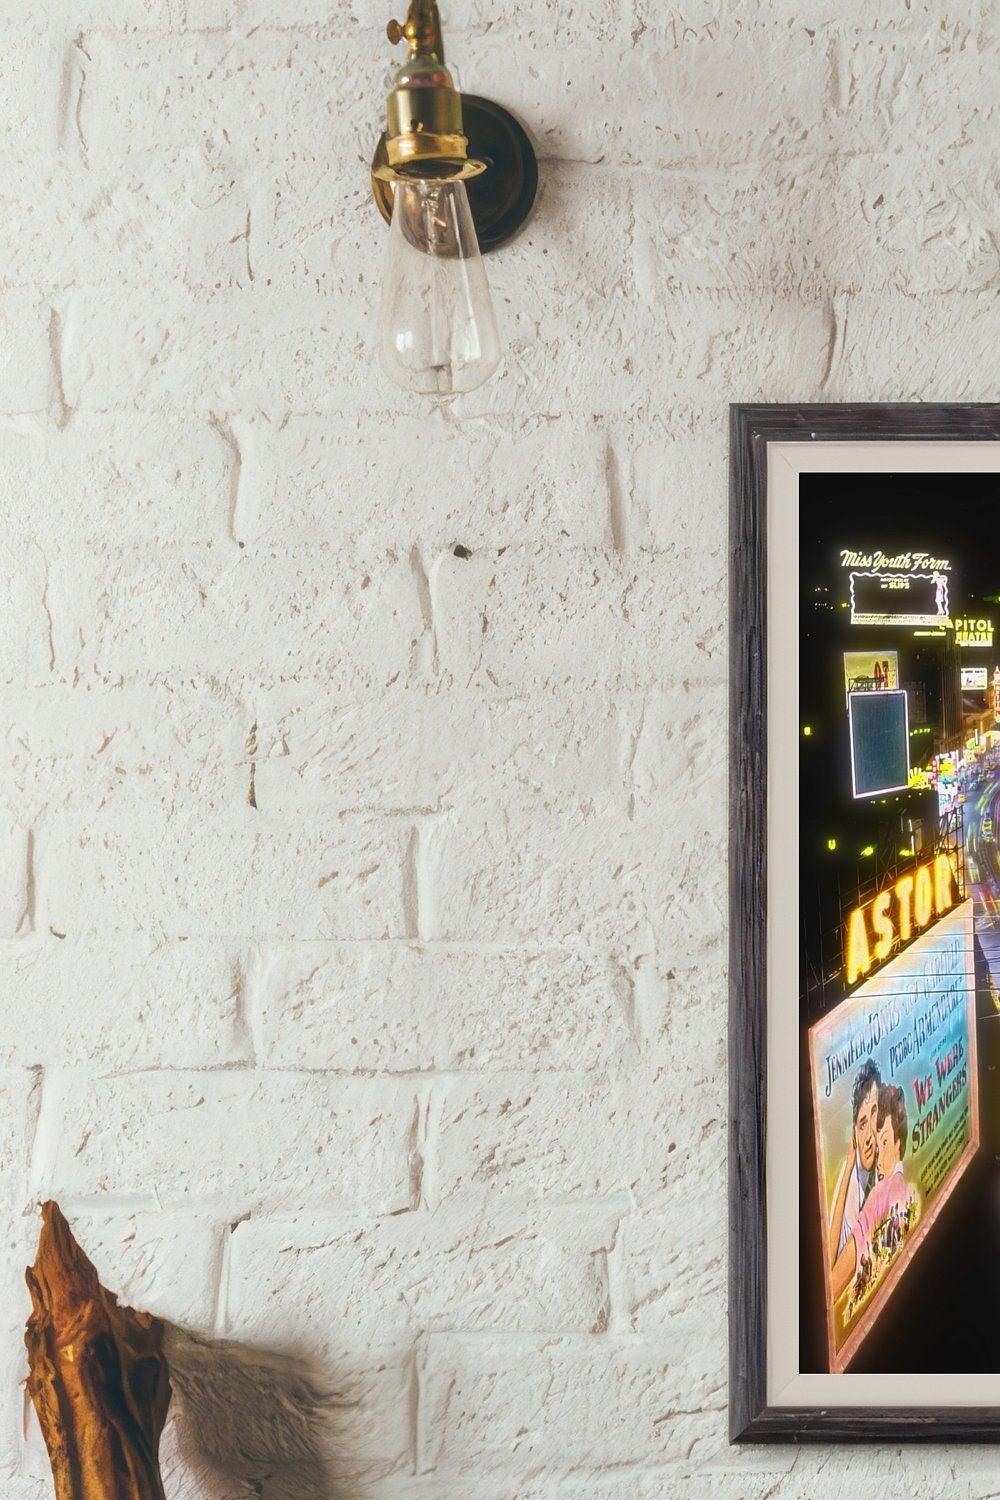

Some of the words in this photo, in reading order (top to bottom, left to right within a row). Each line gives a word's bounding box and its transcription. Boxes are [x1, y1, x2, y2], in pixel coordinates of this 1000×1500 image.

[840, 550, 872, 567] Miss
[871, 551, 912, 573] Youth
[910, 552, 952, 571] Form
[847, 853, 954, 985] ASTOR
[825, 1031, 866, 1097] JENNIFER
[911, 1062, 968, 1154] STRANGERS
